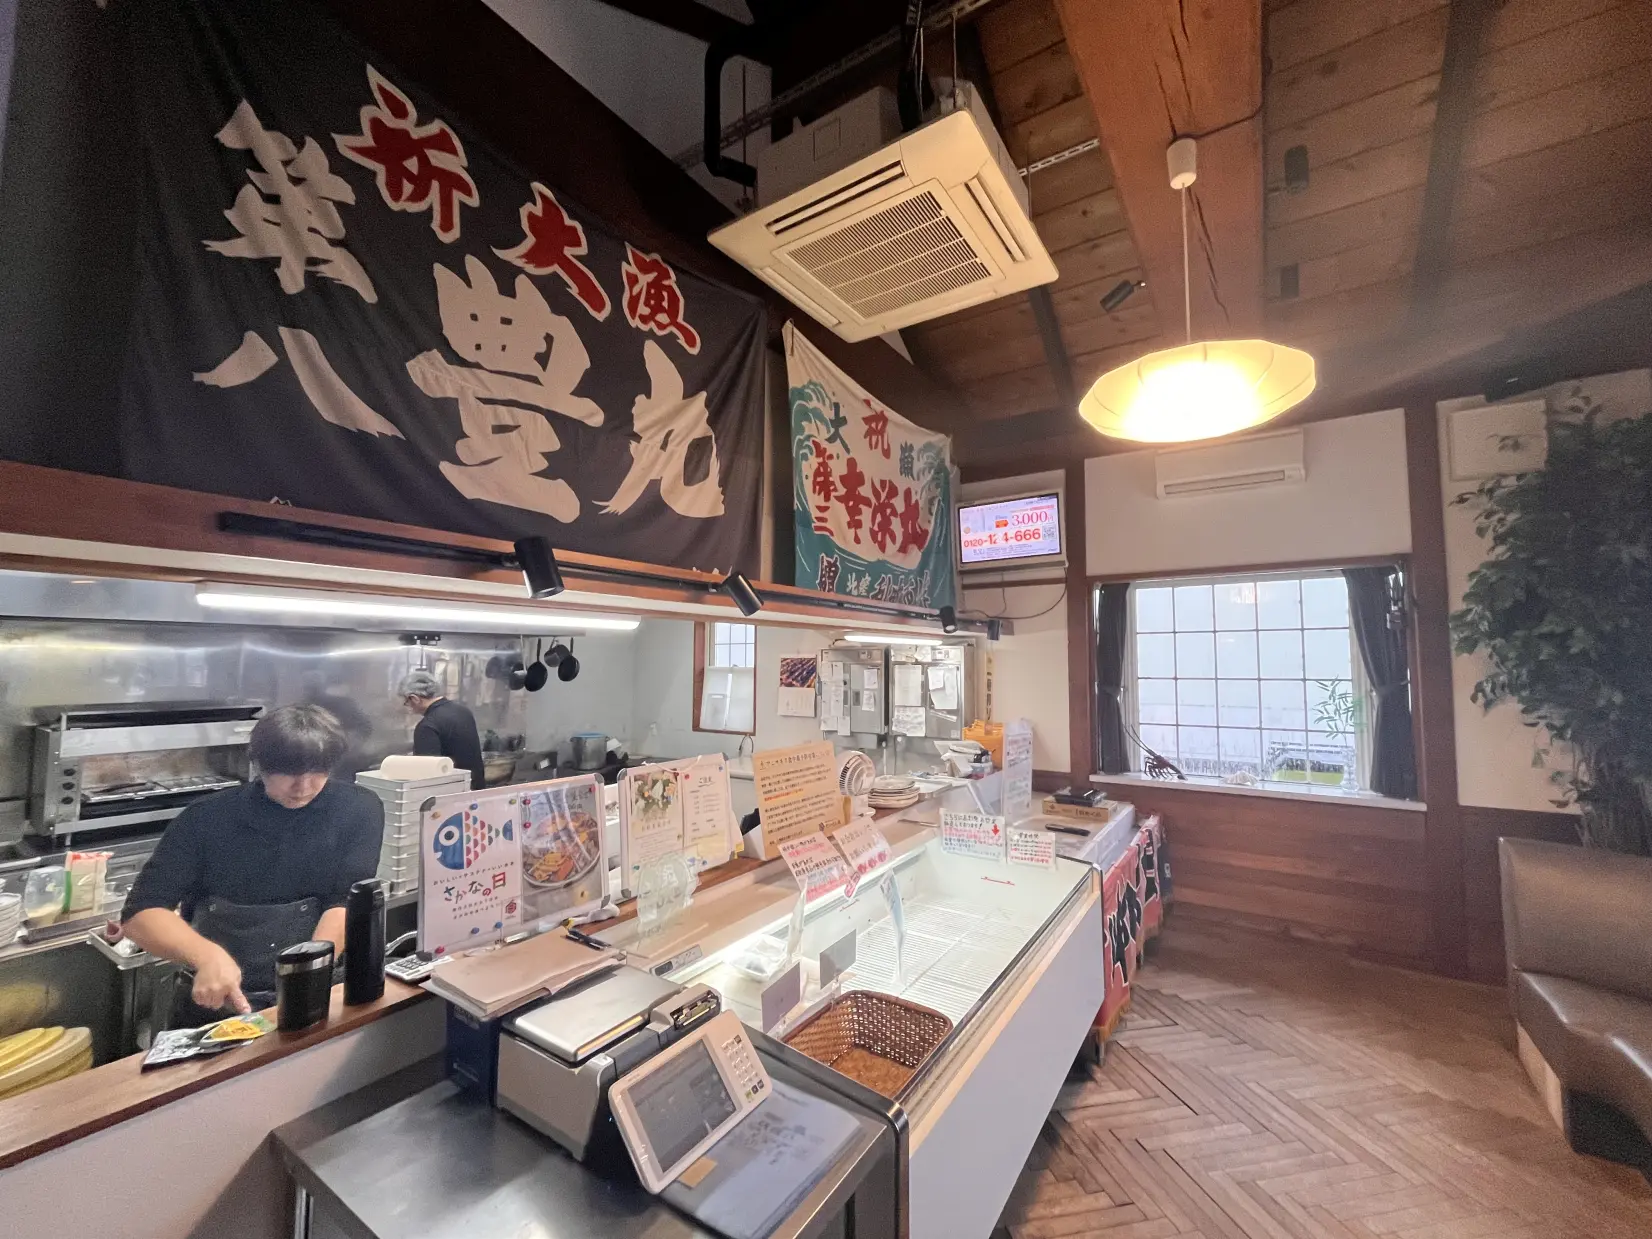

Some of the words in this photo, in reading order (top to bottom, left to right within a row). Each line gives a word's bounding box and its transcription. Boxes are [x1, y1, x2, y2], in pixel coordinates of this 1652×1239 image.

[331, 63, 701, 355] 祈大漁
[443, 871, 506, 904] さかなの日
